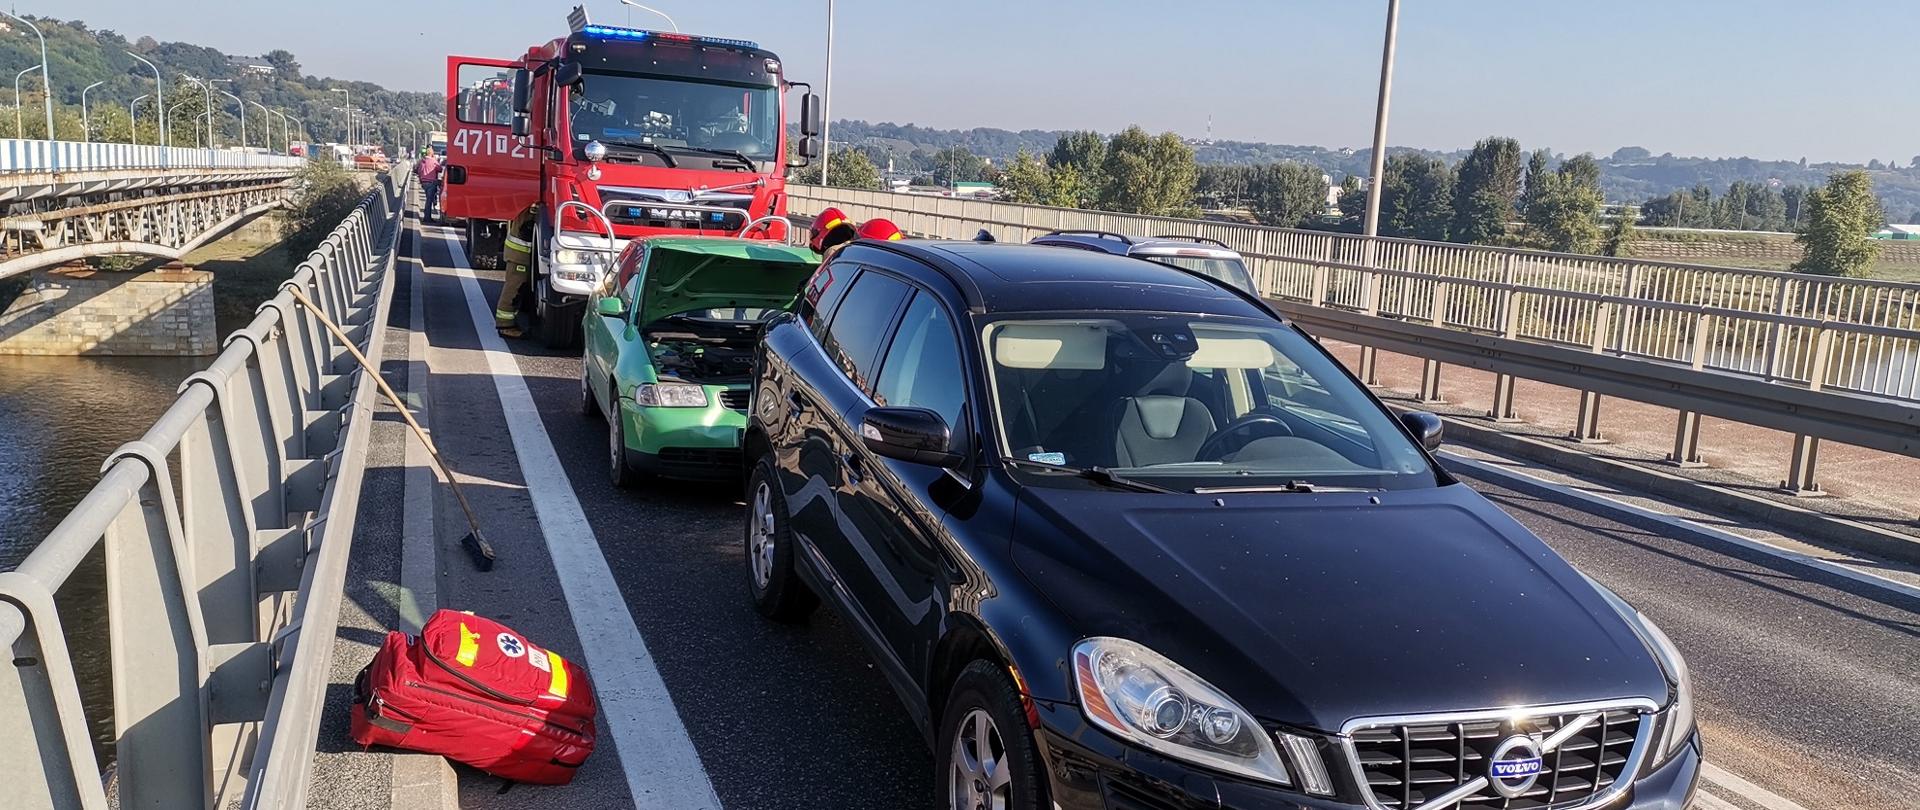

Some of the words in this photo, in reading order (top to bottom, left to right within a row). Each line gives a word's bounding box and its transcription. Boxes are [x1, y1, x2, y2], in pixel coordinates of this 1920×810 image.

[453, 128, 492, 155] 471
[511, 134, 535, 159] 21
[651, 208, 701, 220] MAN
[1495, 761, 1539, 774] VOLVO
